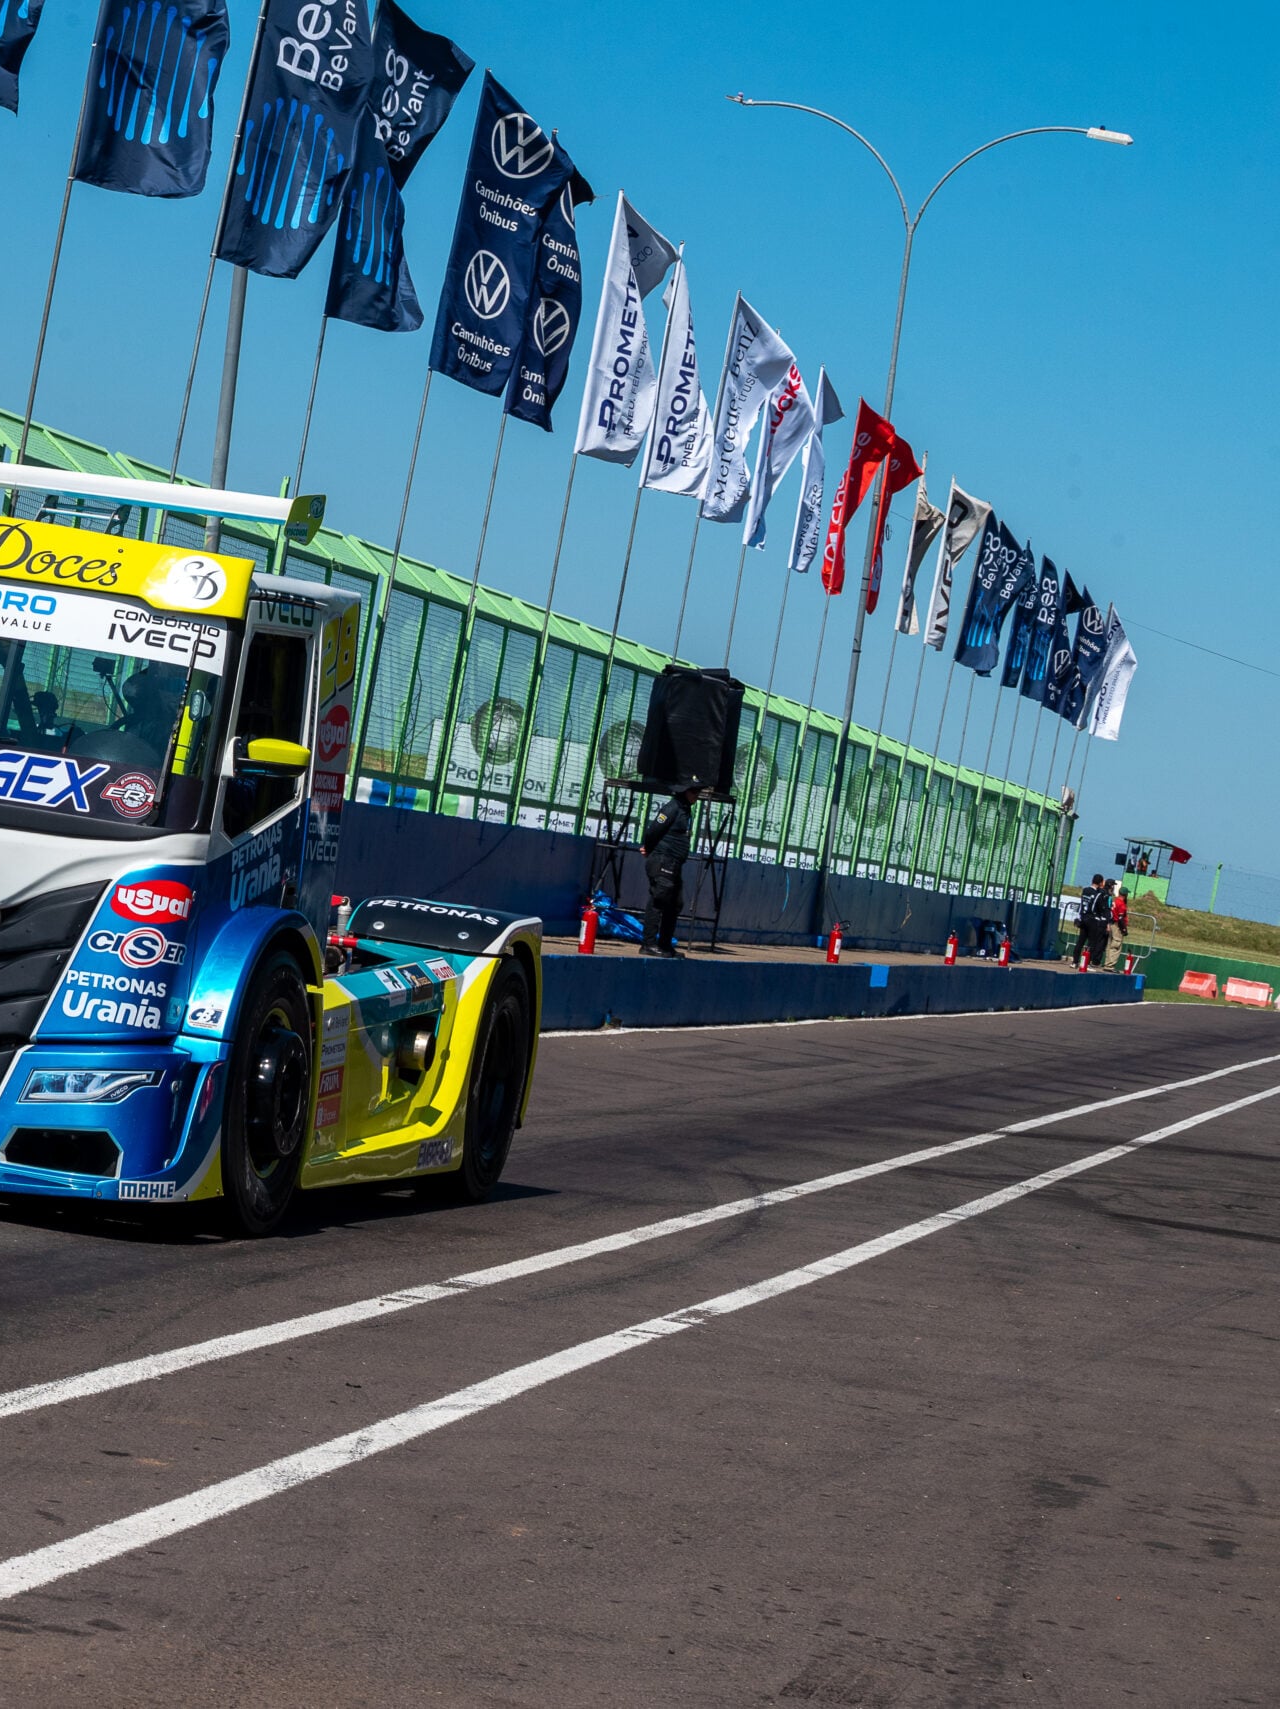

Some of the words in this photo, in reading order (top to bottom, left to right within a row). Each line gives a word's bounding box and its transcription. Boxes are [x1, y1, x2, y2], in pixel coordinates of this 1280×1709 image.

[276, 0, 337, 81] Be
[320, 0, 356, 91] BeVan
[475, 179, 536, 217] Caminhões
[479, 201, 519, 232] Ônibus
[542, 232, 578, 261] Camin
[546, 254, 580, 284] Ônibu
[451, 321, 511, 358] Caminhões
[598, 267, 639, 439] PROMETE
[456, 343, 493, 374] Ônibus
[1, 616, 52, 633] VALUE
[113, 608, 221, 638] CONSÓRCIO
[108, 623, 217, 659] IVECO
[320, 603, 360, 706] 28
[447, 760, 547, 794] PROMETON
[231, 822, 283, 873] PETRONAS
[306, 839, 339, 862] IVECO
[229, 847, 281, 912] Urania
[367, 899, 500, 926] PETRONAS
[88, 929, 187, 967] CISER
[66, 969, 168, 998] PETRONAS
[62, 989, 162, 1030] Urania
[120, 1181, 175, 1199] MAHLE
